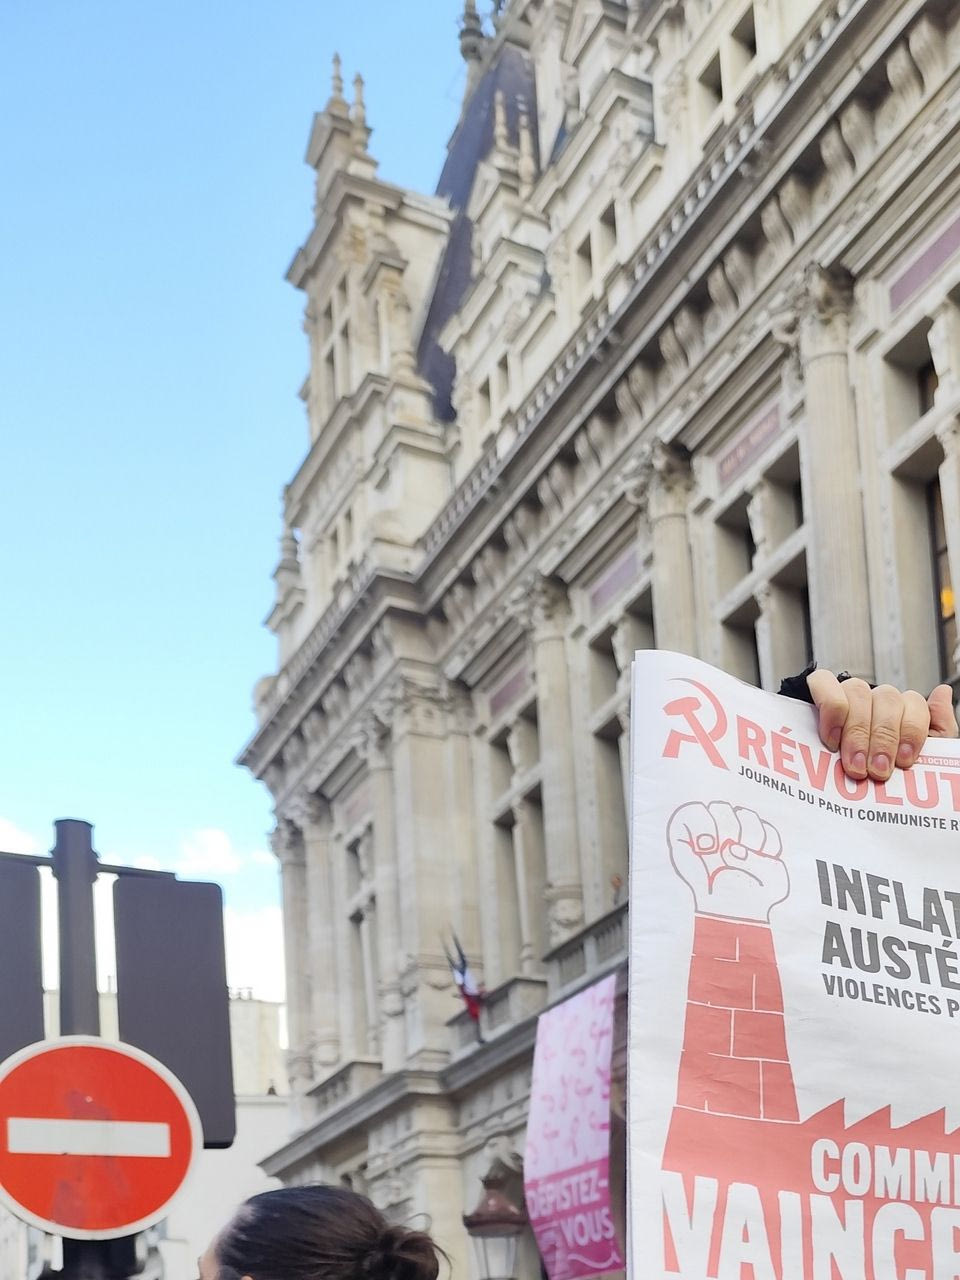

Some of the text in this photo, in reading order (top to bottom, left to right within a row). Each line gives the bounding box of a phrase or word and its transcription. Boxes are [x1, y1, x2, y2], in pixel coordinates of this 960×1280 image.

[738, 765, 795, 798] JOURNAL
[799, 789, 815, 805] DU
[818, 797, 853, 819] PARTI
[857, 809, 947, 830] COMMUNISTE
[822, 973, 942, 1015] VIOLENCES
[560, 1206, 615, 1248] VOUS
